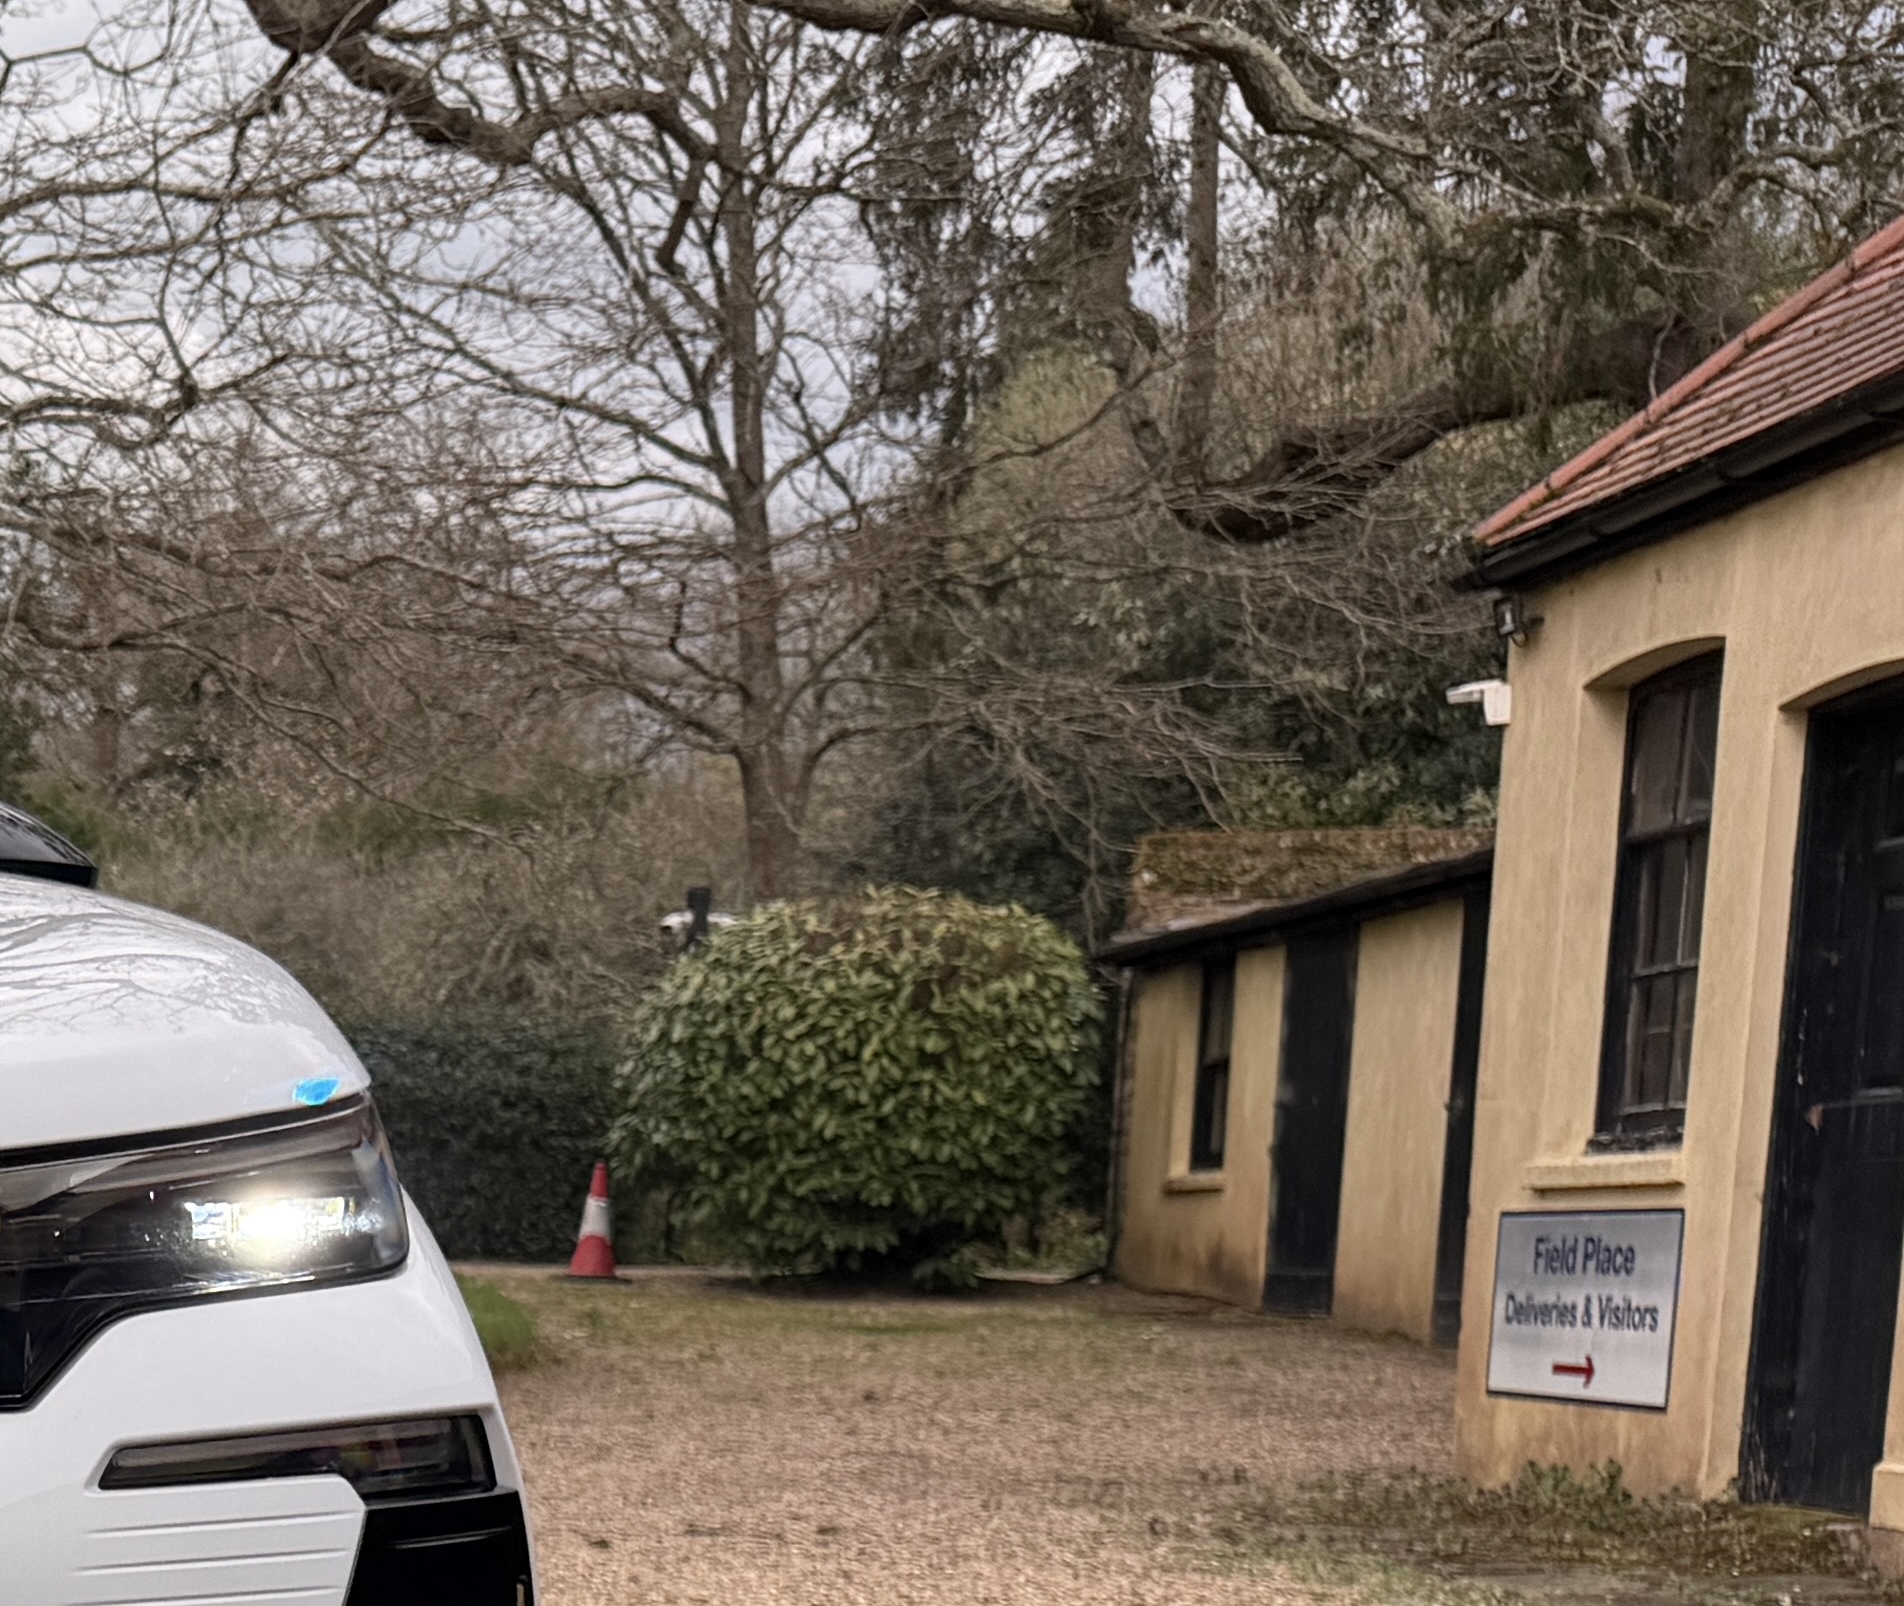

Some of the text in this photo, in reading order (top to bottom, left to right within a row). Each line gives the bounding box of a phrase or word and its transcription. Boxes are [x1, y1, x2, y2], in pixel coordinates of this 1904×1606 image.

[1534, 1236, 1635, 1276] Field Place
[1505, 1293, 1658, 1332] Deliveries & Visitors
